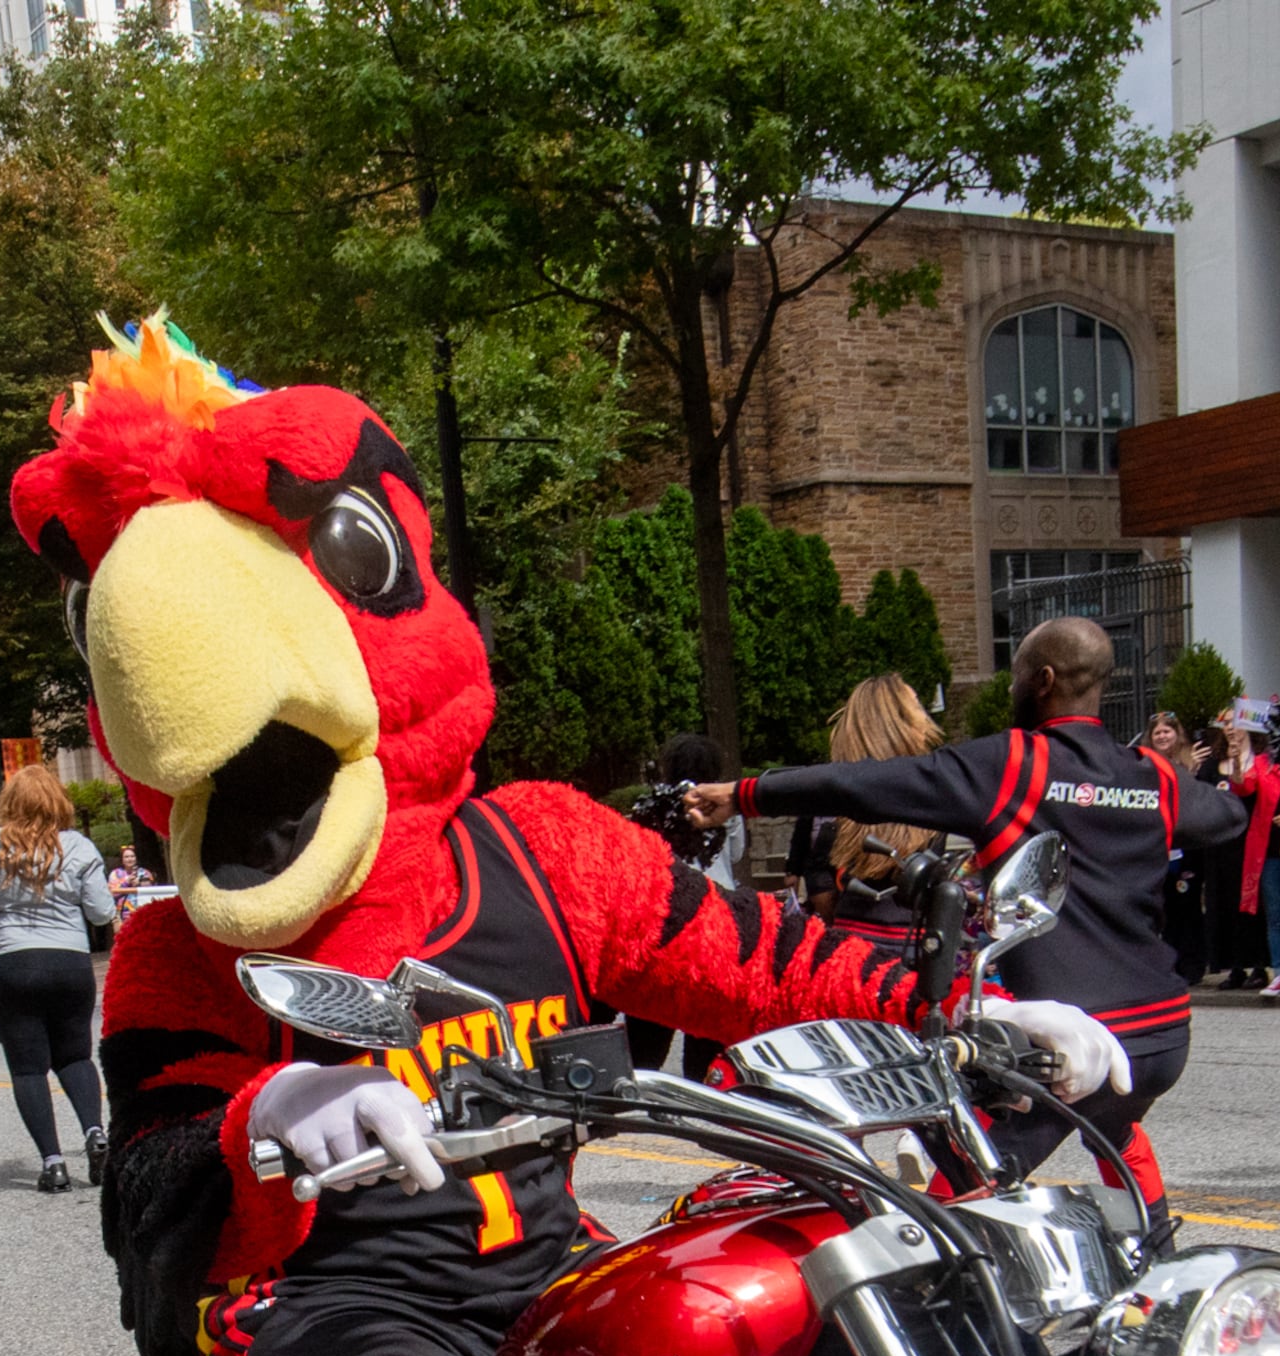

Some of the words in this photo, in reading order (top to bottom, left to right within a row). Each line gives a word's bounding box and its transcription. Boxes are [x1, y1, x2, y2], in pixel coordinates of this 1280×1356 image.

[1045, 781, 1078, 804] ATL
[1093, 786, 1160, 810] DANCERS
[341, 995, 568, 1106] AWKS
